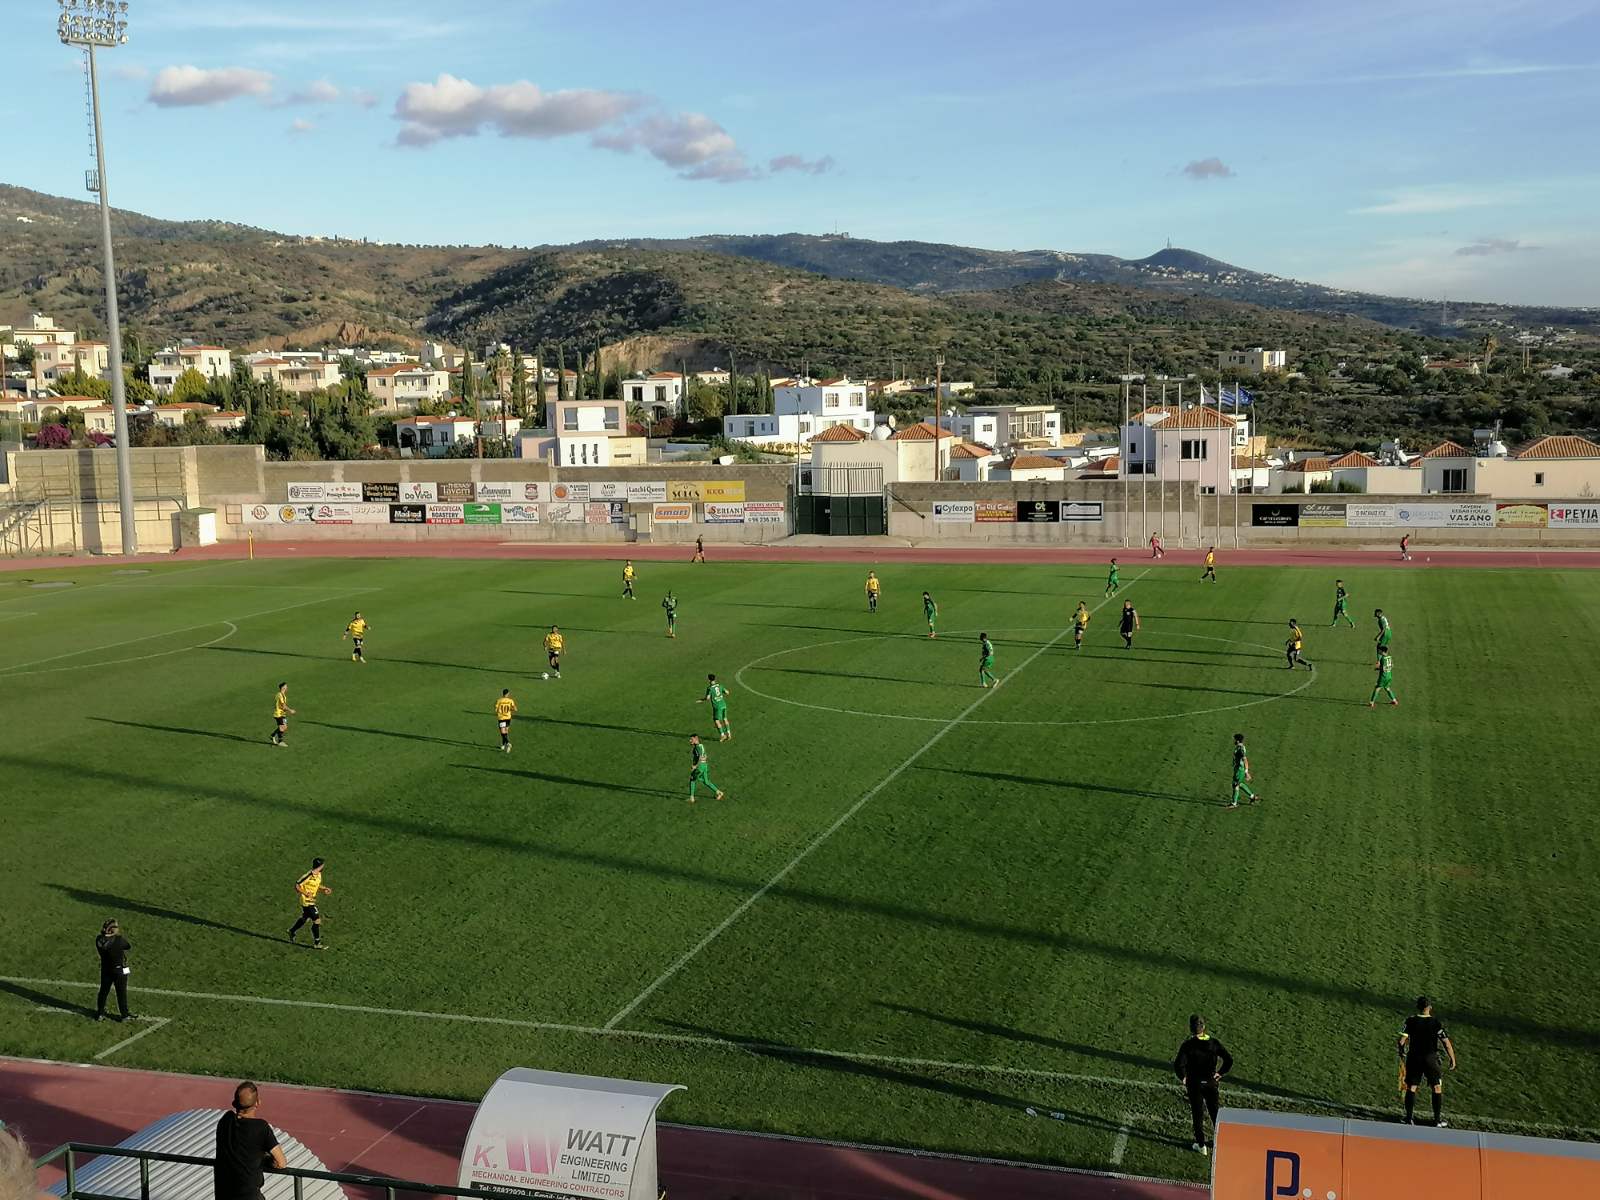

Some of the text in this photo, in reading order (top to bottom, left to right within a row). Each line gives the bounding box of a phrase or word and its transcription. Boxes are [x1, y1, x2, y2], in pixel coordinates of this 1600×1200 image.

[1565, 508, 1599, 519] PEYIA
[499, 704, 510, 714] 10
[566, 1127, 637, 1157] WATT
[560, 1154, 628, 1173] ENGINEERING
[471, 1170, 625, 1198] MECHANICAL ENGINEERING CONTRACTORS
[571, 1169, 611, 1184] LIMITED
